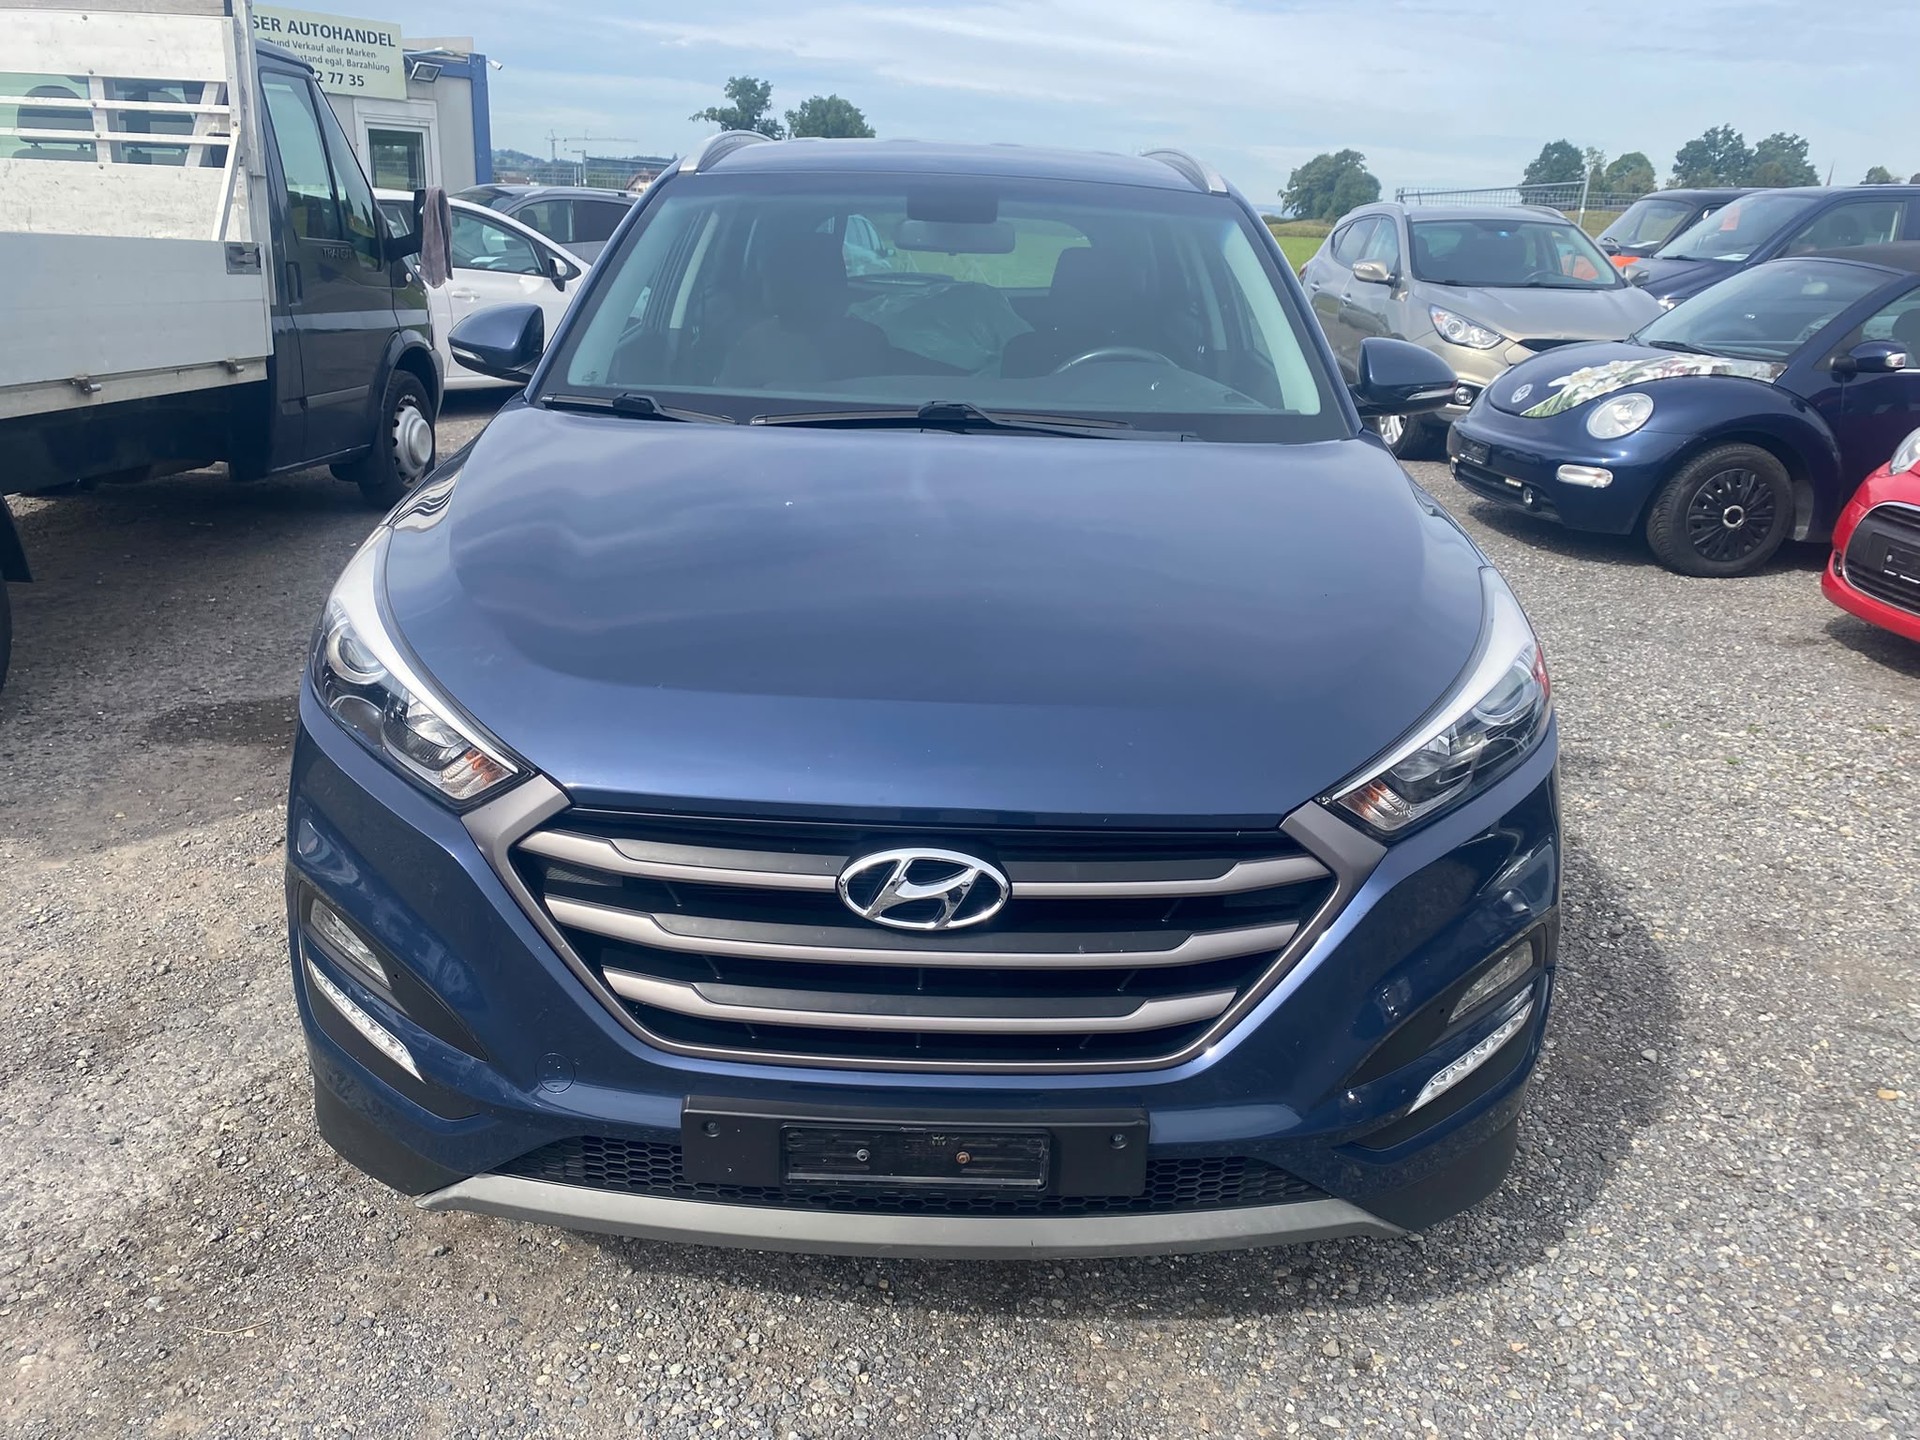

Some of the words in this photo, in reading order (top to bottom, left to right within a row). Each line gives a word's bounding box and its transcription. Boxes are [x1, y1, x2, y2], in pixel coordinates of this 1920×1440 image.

[287, 20, 396, 47] AUTOHANDEL
[292, 39, 324, 52] Verkauf
[326, 44, 344, 54] aller
[346, 47, 376, 58] Marken
[325, 58, 345, 67] egal,
[346, 59, 390, 74] Barzahlung
[328, 72, 344, 85] 77
[349, 74, 365, 87] 35
